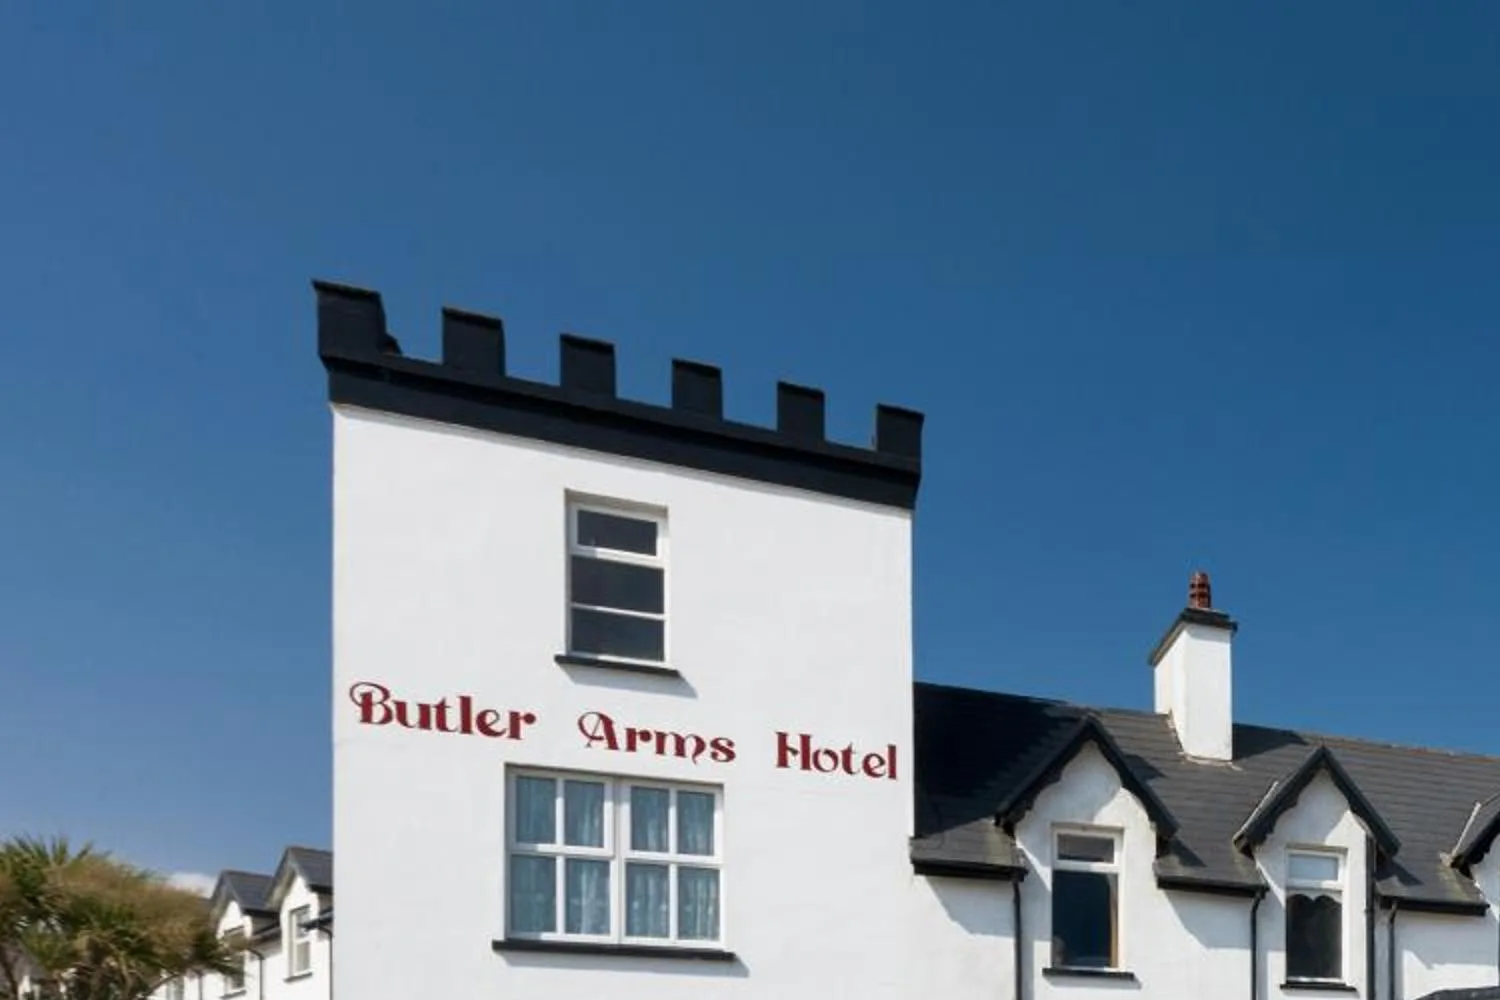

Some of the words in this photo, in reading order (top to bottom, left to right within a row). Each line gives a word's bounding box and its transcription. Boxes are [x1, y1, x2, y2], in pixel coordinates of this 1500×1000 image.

[349, 681, 537, 740] Butler
[577, 711, 736, 765] Arms
[776, 731, 898, 780] Hotel
